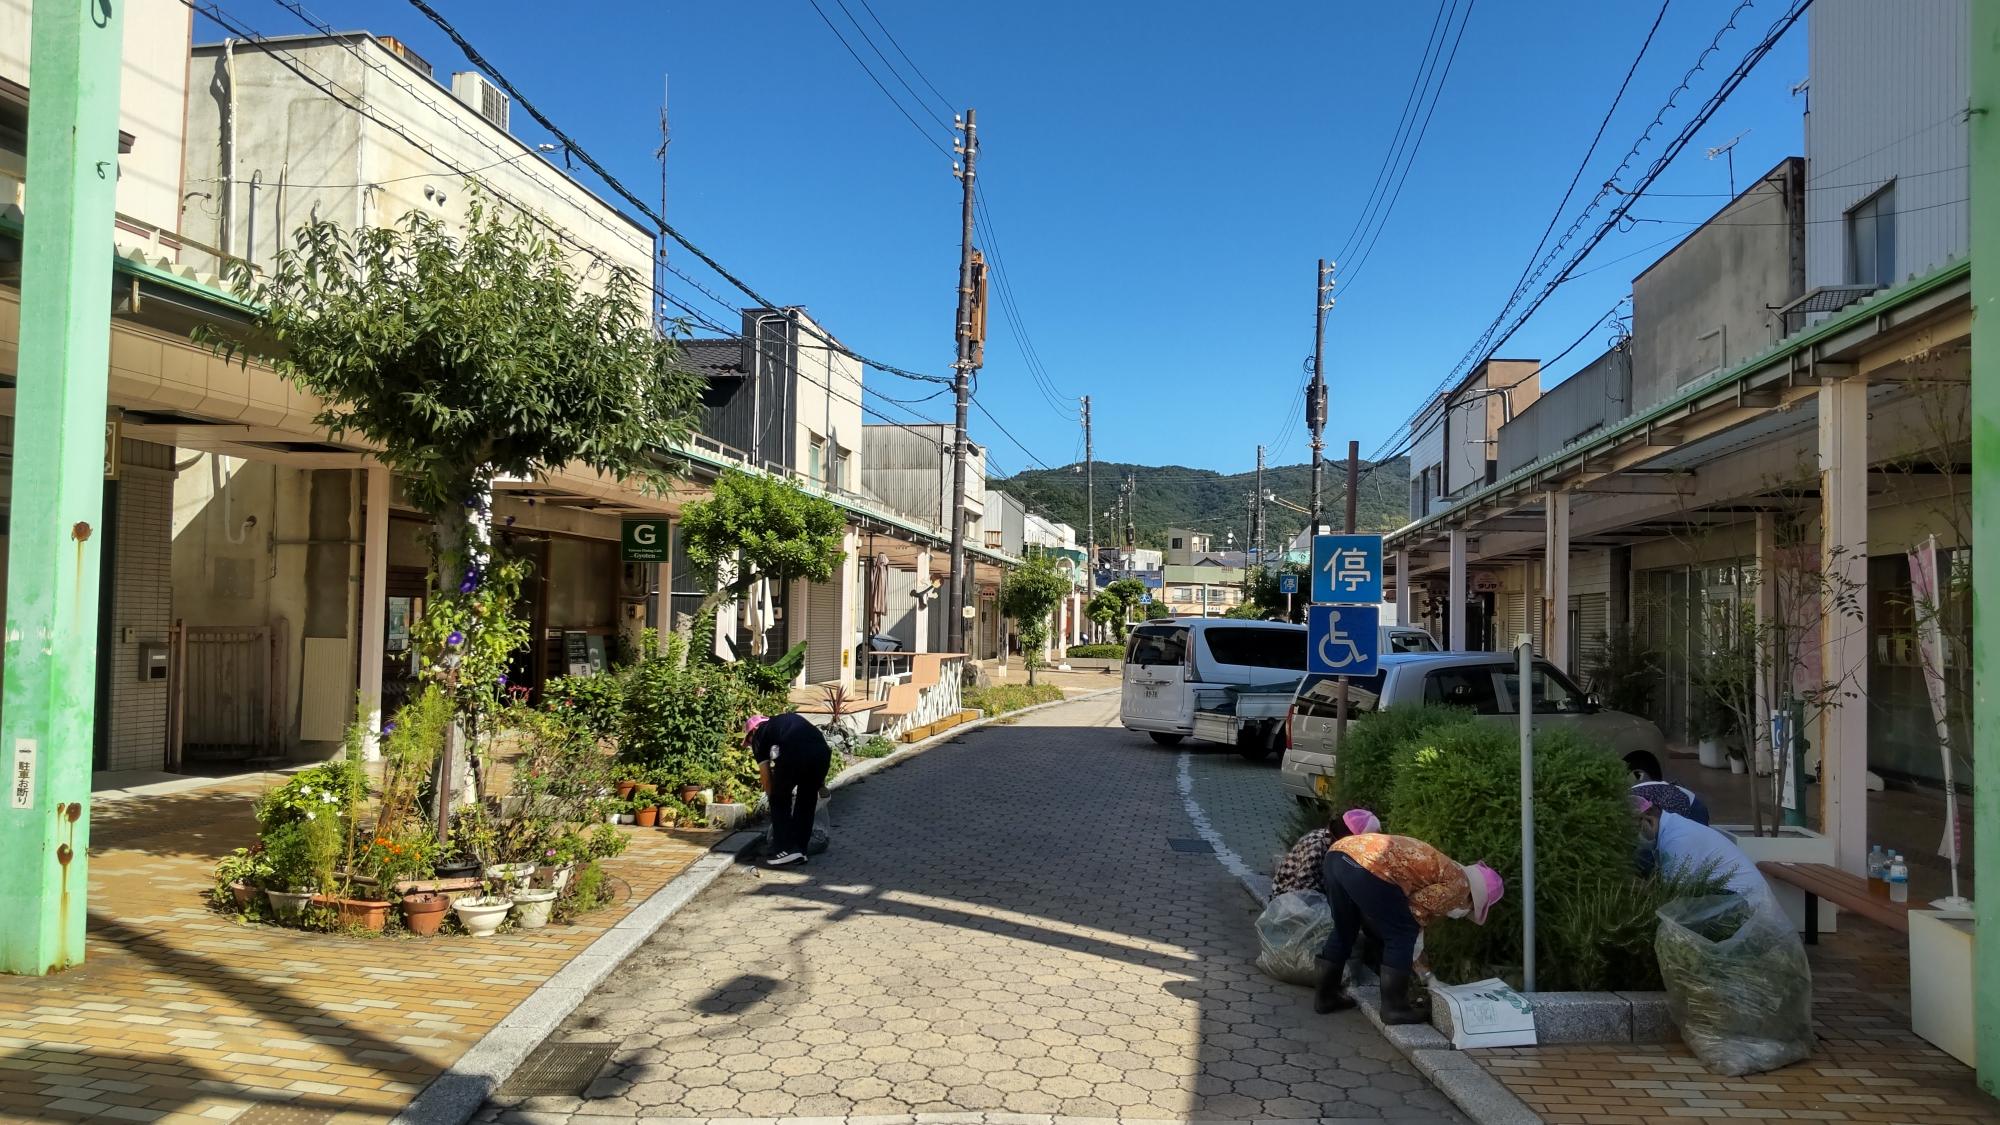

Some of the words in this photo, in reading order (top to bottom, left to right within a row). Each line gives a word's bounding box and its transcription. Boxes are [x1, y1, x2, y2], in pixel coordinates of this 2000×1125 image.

[633, 524, 657, 545] G
[633, 552, 656, 560] Gyoten
[1323, 547, 1371, 592] 停
[1283, 578, 1295, 590] 停
[16, 761, 31, 806] 駐車お断り
